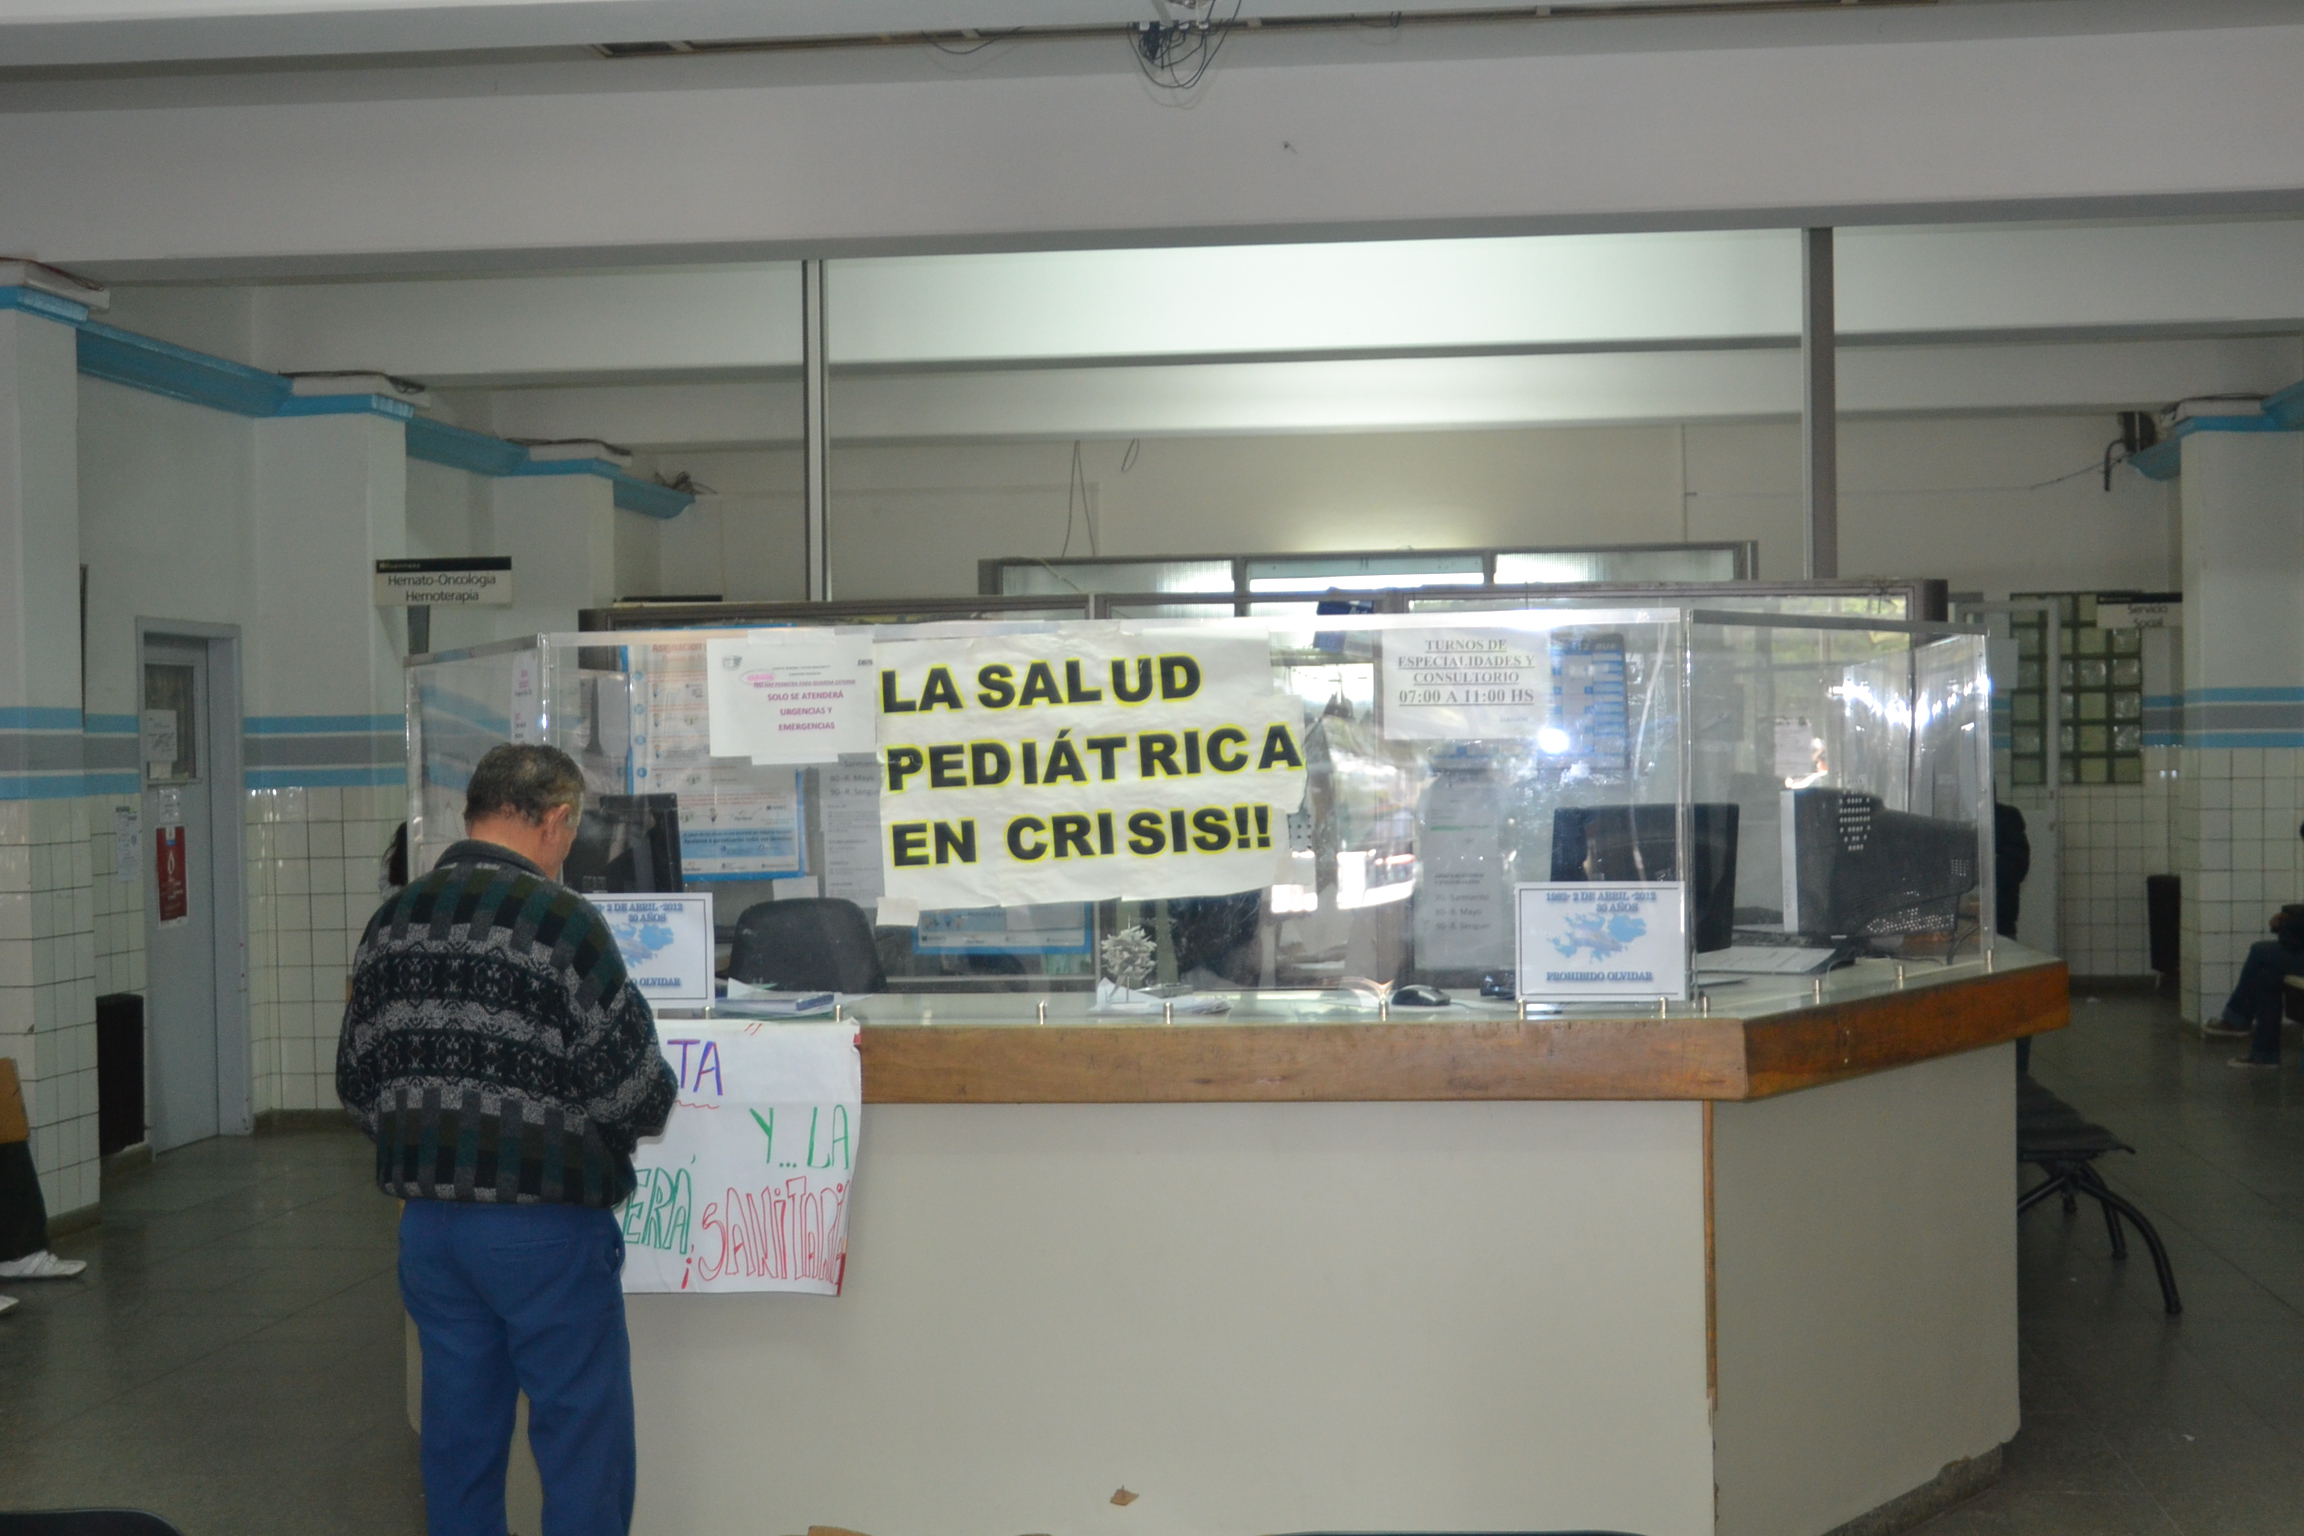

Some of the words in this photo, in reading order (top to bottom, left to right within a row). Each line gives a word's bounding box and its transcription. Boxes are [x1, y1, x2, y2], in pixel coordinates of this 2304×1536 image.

[406, 590, 479, 604] Hemoterapia
[1424, 639, 1483, 651] TURNOS
[1488, 639, 1508, 650] DE
[1397, 656, 1522, 667] ESPECIALIDADES
[1523, 655, 1536, 666] Y
[1413, 671, 1520, 683] CONSULTORIO
[881, 666, 964, 713] LA
[978, 653, 1201, 708] SALUD
[767, 692, 789, 701] SOLO
[790, 692, 800, 700] SE
[801, 690, 844, 700] ATENDERÁ
[1398, 690, 1442, 703] 07:00
[1446, 691, 1459, 703] A
[1464, 690, 1506, 702] 11:00
[1511, 689, 1535, 702] HS
[780, 707, 826, 716] URGENCIAS
[827, 706, 833, 714] Y
[778, 721, 835, 731] EMERGENCIAS
[886, 722, 1303, 791] PEDIÁTRICA
[892, 818, 979, 867] EN
[1006, 804, 1272, 861] CRISIS!!
[1573, 892, 1579, 901] 2
[1581, 892, 1596, 901] DE
[1597, 892, 1630, 901] ABRIL
[606, 903, 613, 912] 2
[614, 903, 628, 912] DE
[629, 903, 659, 912] ABRIL
[1609, 902, 1639, 913] AÑOS
[640, 912, 666, 922] AÑOS
[1546, 971, 1605, 981] PROHIBIDO
[1606, 971, 1653, 981] OLVIDAR
[639, 978, 681, 987] OLVIDAR
